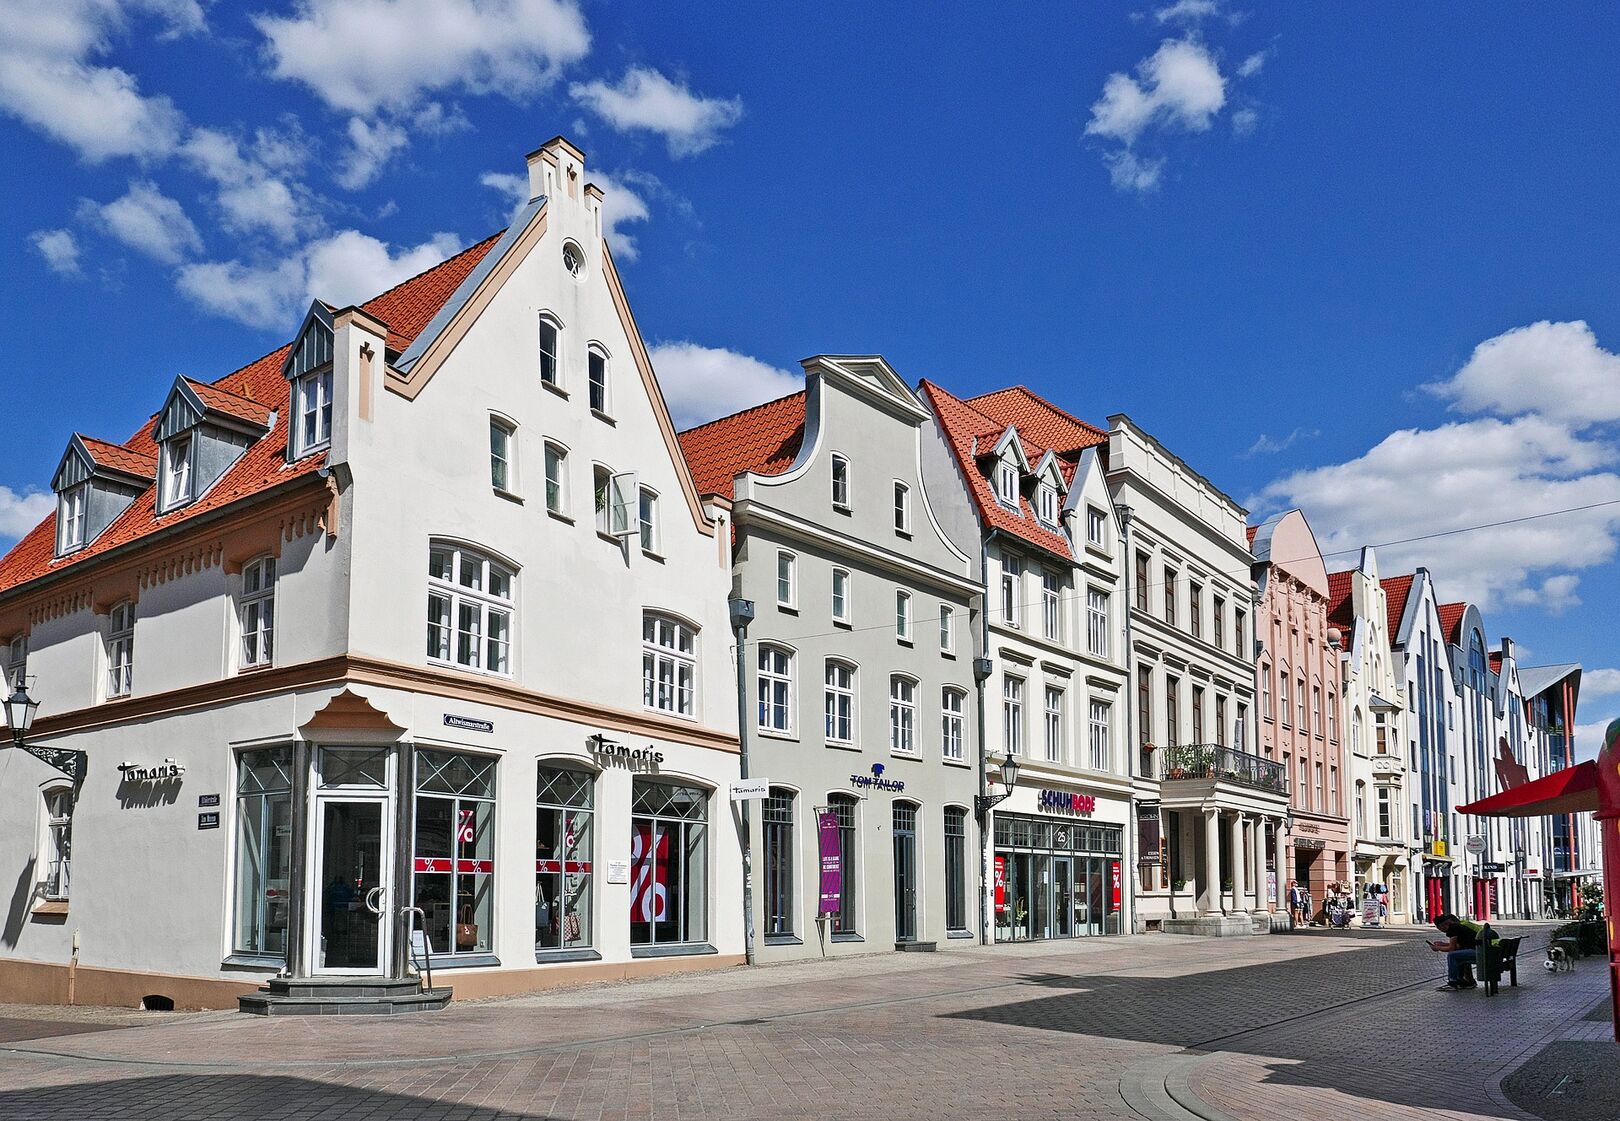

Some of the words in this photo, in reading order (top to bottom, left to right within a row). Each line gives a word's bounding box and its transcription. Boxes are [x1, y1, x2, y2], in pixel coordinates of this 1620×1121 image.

[590, 733, 664, 762] Tamaris
[117, 758, 179, 781] Tamaris
[732, 785, 766, 793] Tamaris
[850, 774, 872, 787] TOM
[872, 777, 905, 791] TAILOR
[1057, 831, 1066, 843] 25
[425, 858, 435, 873] %
[471, 860, 482, 873] %
[540, 860, 548, 873] %
[994, 870, 1004, 888] %
[1112, 874, 1121, 889] %
